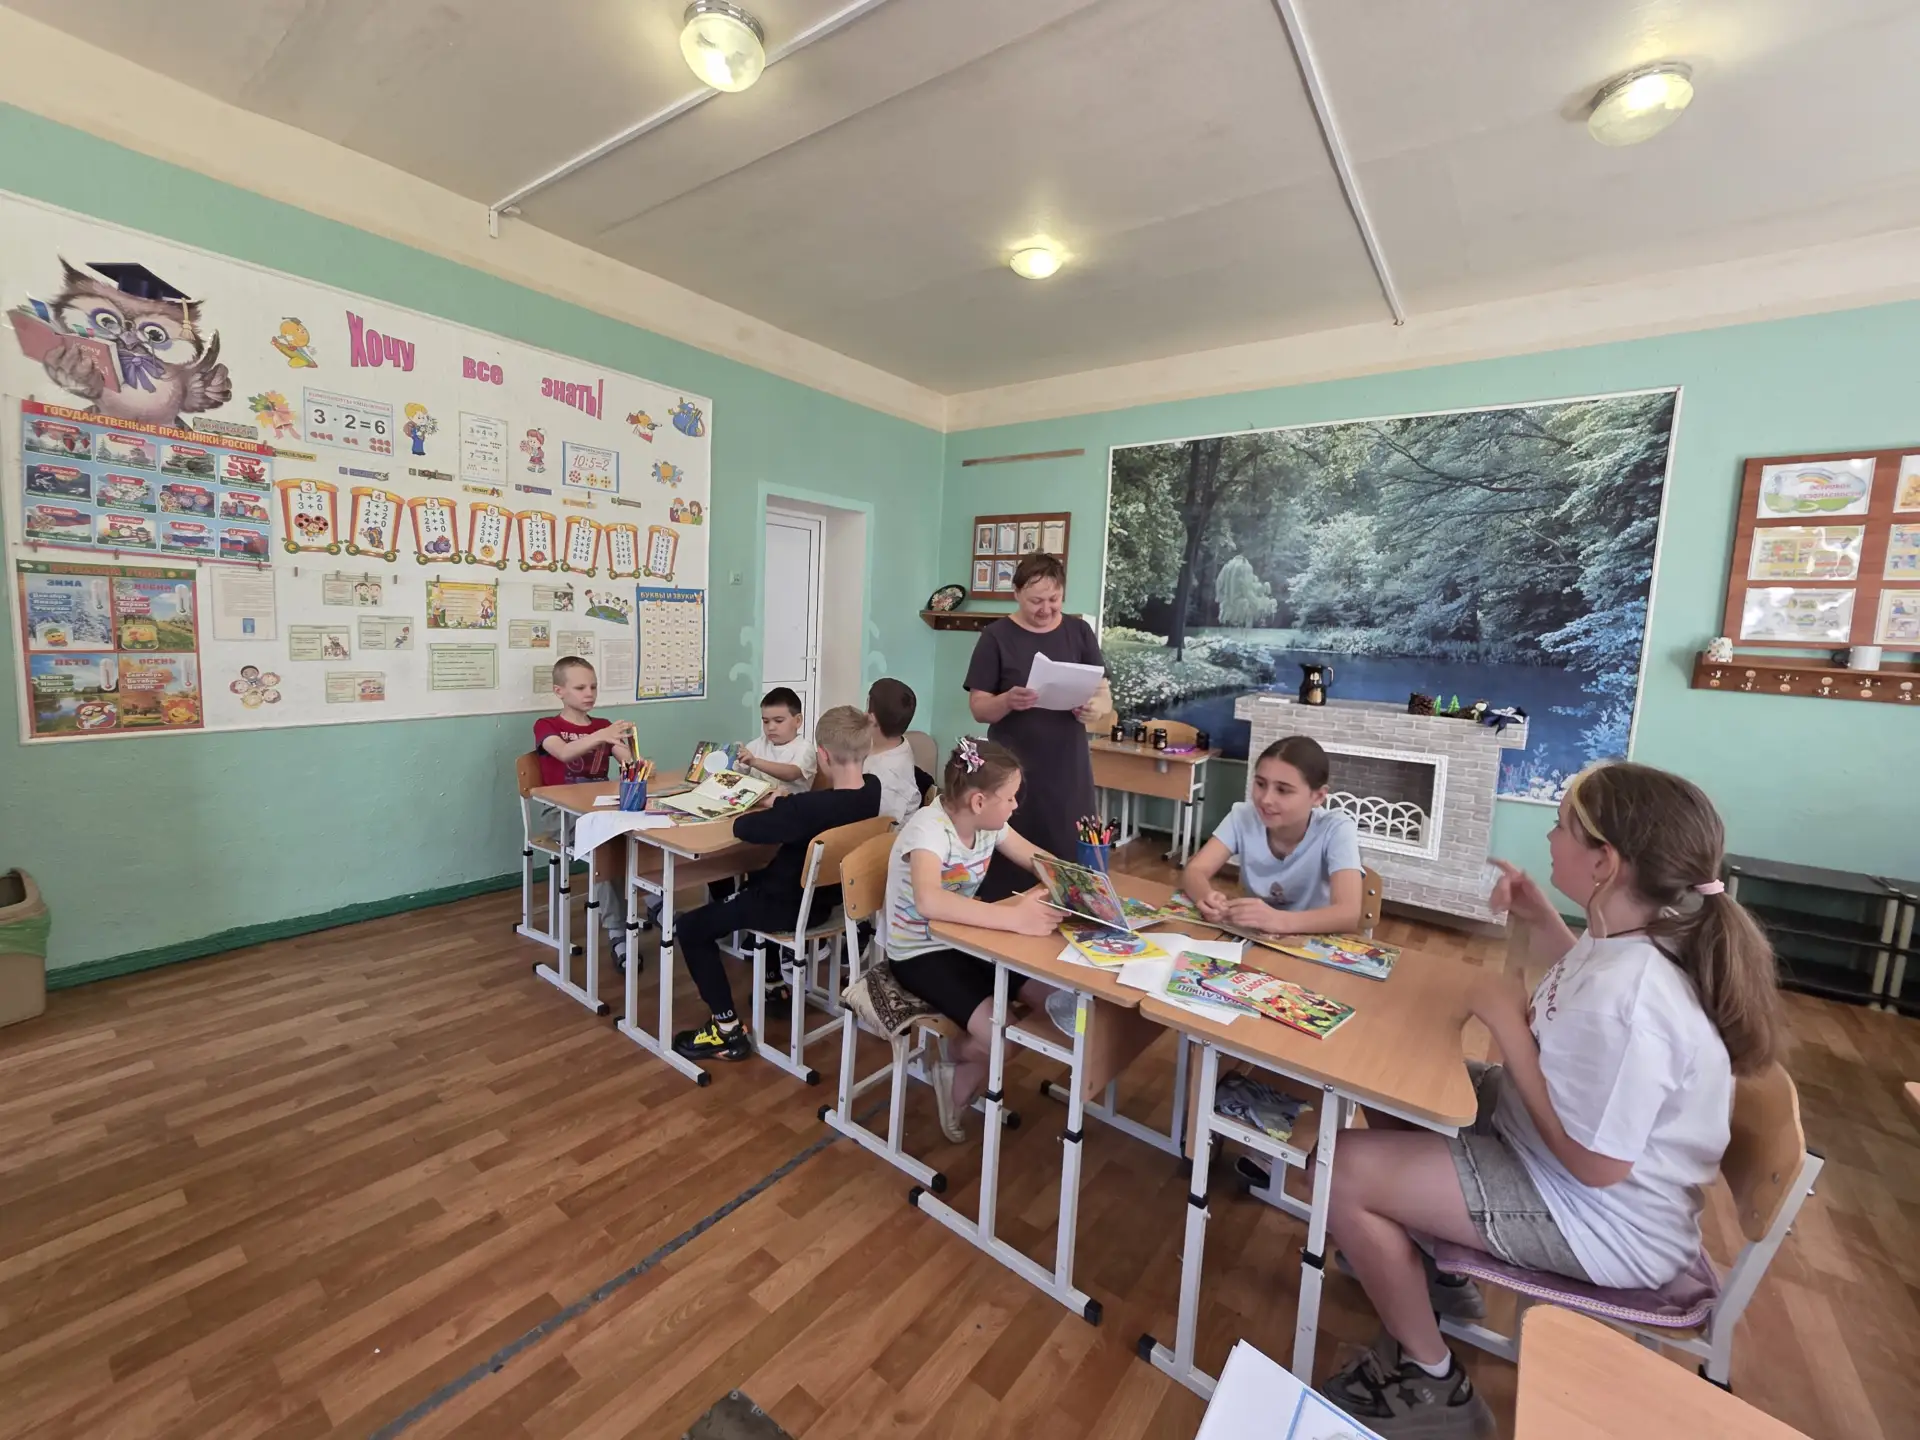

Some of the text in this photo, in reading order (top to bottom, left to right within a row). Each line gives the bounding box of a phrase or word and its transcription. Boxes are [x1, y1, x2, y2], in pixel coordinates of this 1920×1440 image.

[346, 310, 603, 420] Хочу все знать!
[43, 404, 258, 452] ГОСУДАРСТВЕННЫЕ ПРАЗДНИКИ РОССИИ
[314, 409, 326, 424] 3
[345, 414, 356, 429] 2
[375, 420, 385, 434] 6
[47, 579, 82, 587] ЗИМА
